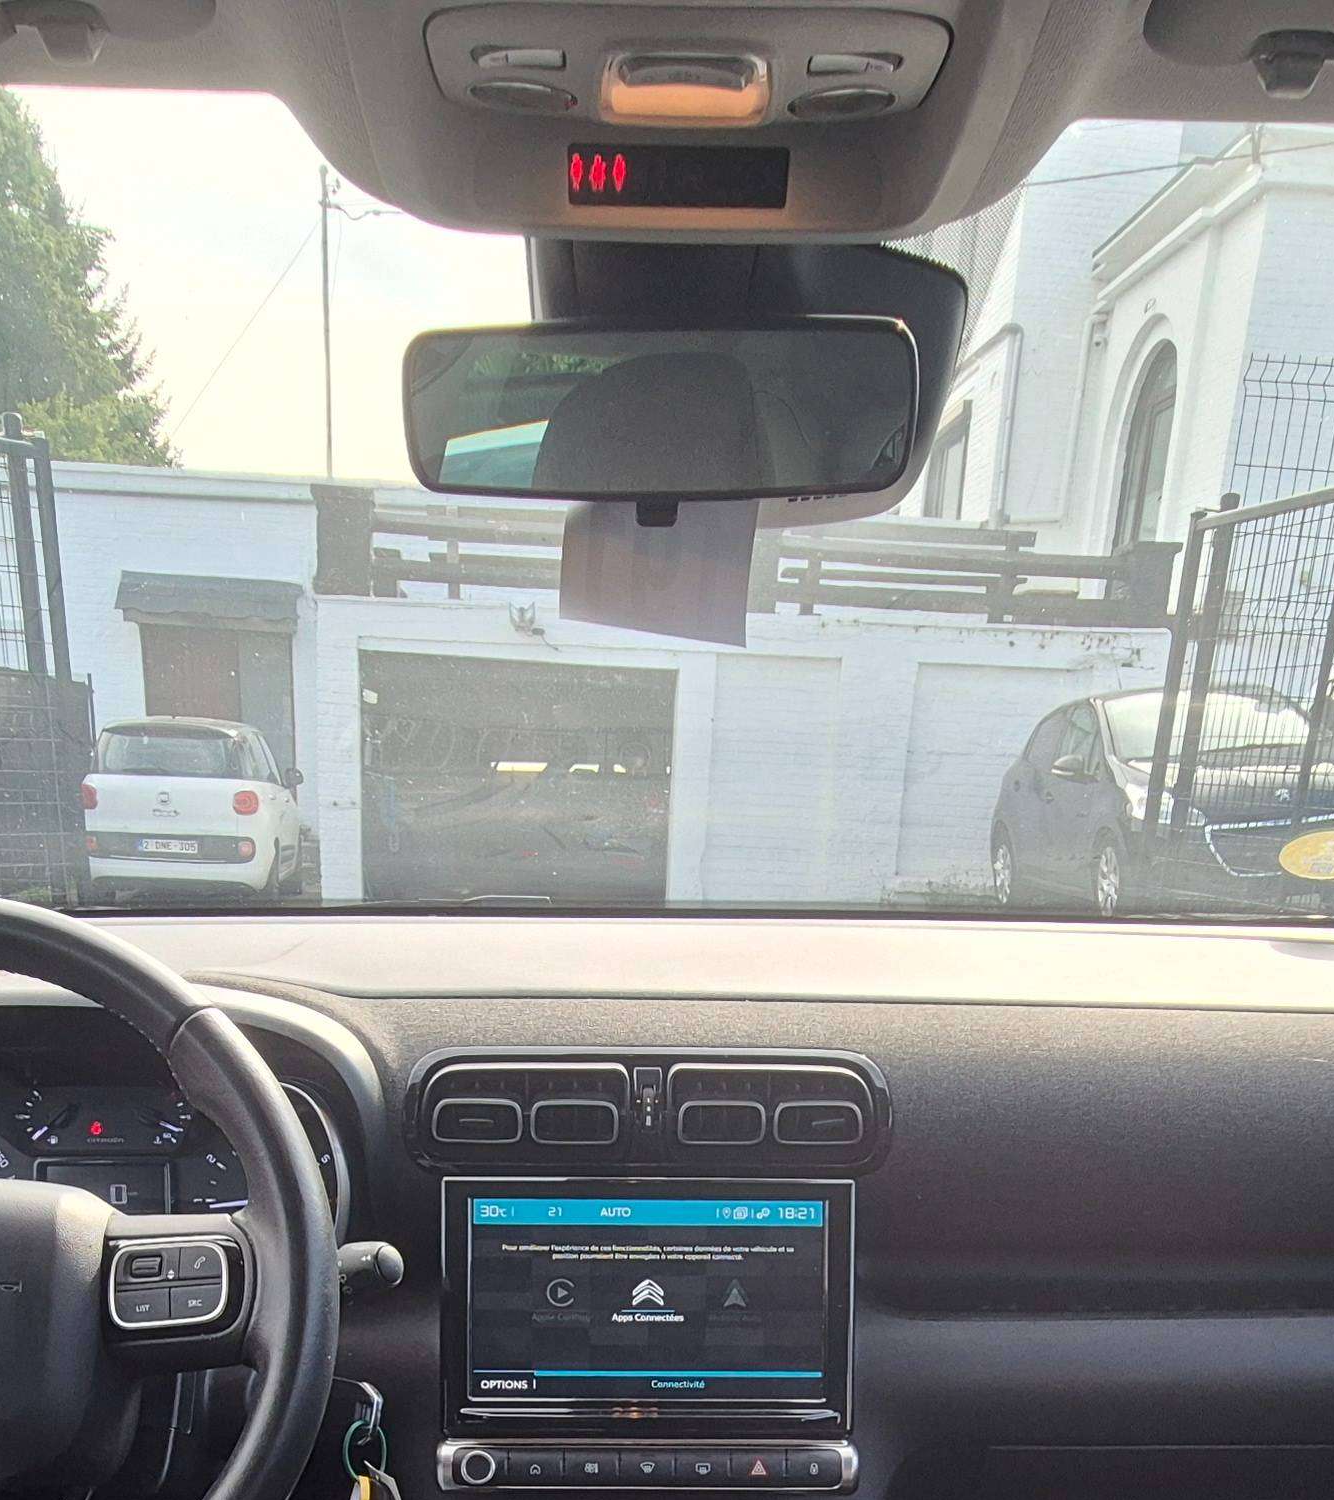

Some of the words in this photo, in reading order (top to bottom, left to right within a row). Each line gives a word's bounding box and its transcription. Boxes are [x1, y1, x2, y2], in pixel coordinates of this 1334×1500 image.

[548, 1207, 562, 1217] 21
[600, 1207, 631, 1217] AUTO
[778, 1207, 815, 1219] 18:21
[136, 1304, 150, 1312] LIST
[612, 1313, 633, 1323] Apps
[480, 1379, 528, 1390] OPTIONS
[651, 1379, 705, 1389] Connectivité
